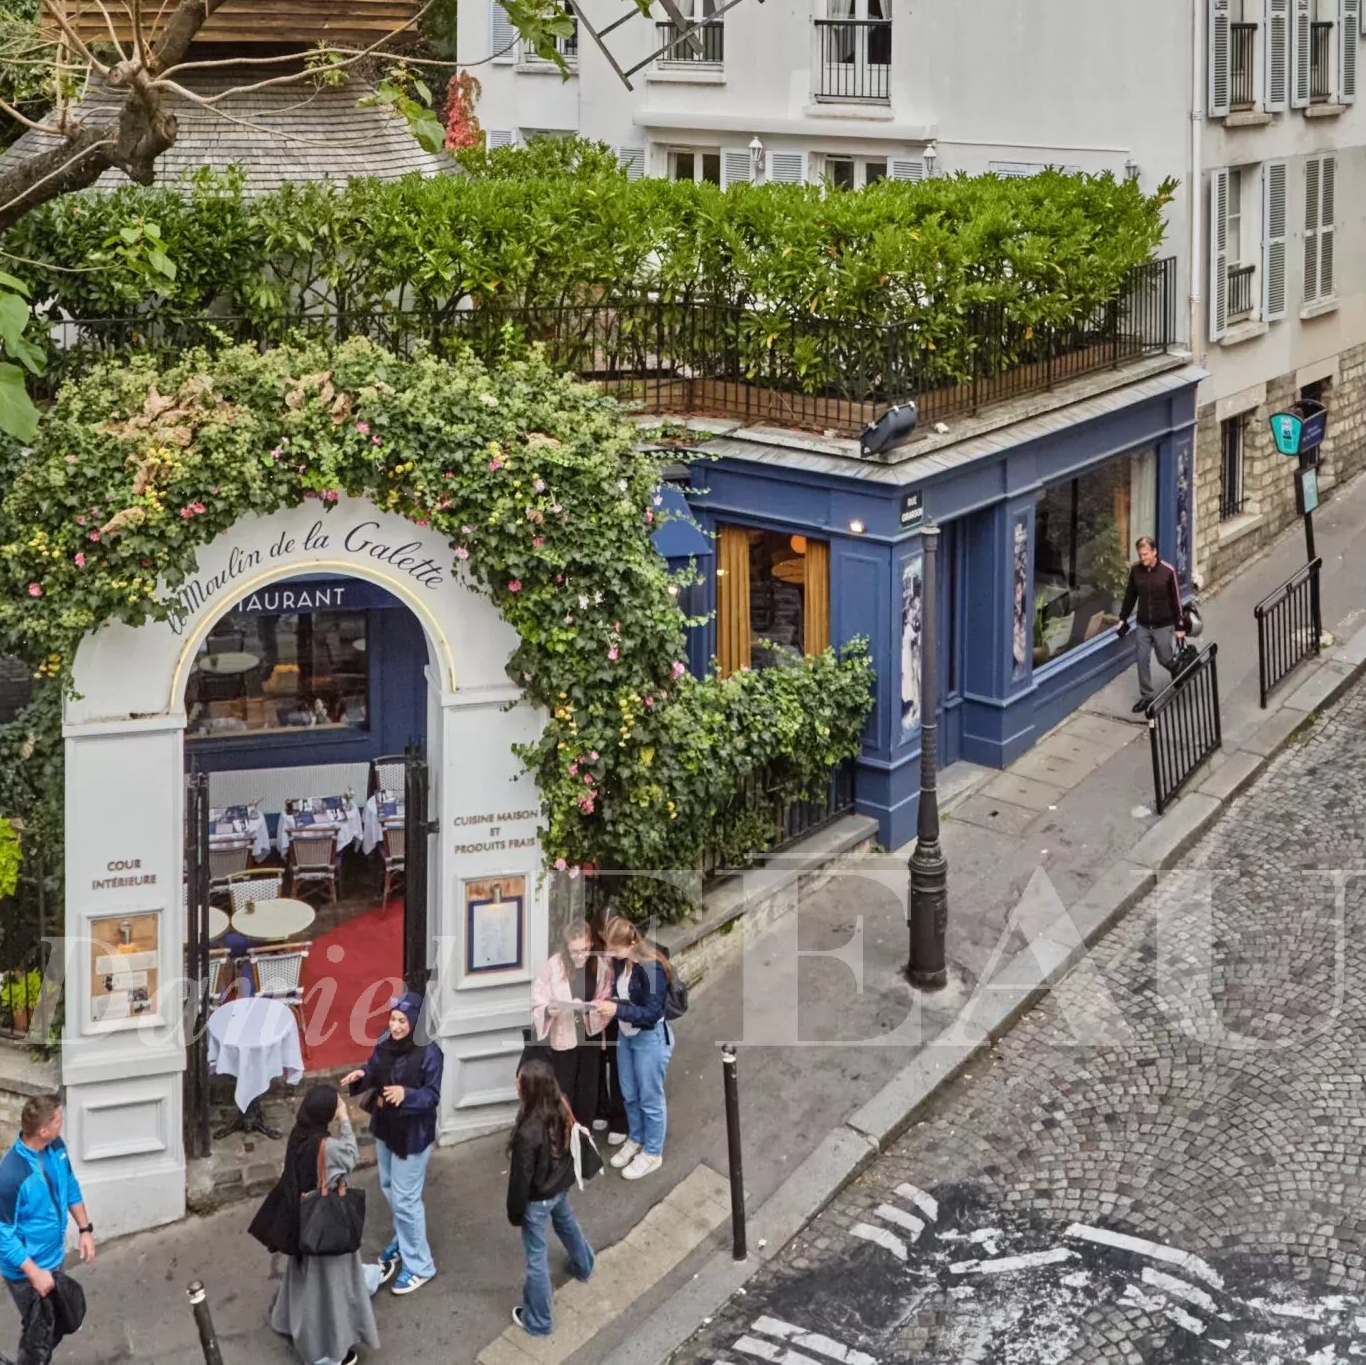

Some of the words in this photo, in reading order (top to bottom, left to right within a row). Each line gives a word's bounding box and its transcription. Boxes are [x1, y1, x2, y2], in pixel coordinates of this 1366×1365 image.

[907, 495, 917, 507] RUE
[178, 546, 263, 615] Moulin
[270, 531, 296, 557] de
[302, 520, 330, 551] la
[344, 521, 444, 590] Galette
[453, 813, 495, 826] CUISINE
[497, 809, 539, 824] MAISON
[490, 827, 501, 836] ET
[454, 841, 506, 854] PRODUITS
[508, 837, 535, 850] FRAIS
[107, 858, 141, 872] COUR
